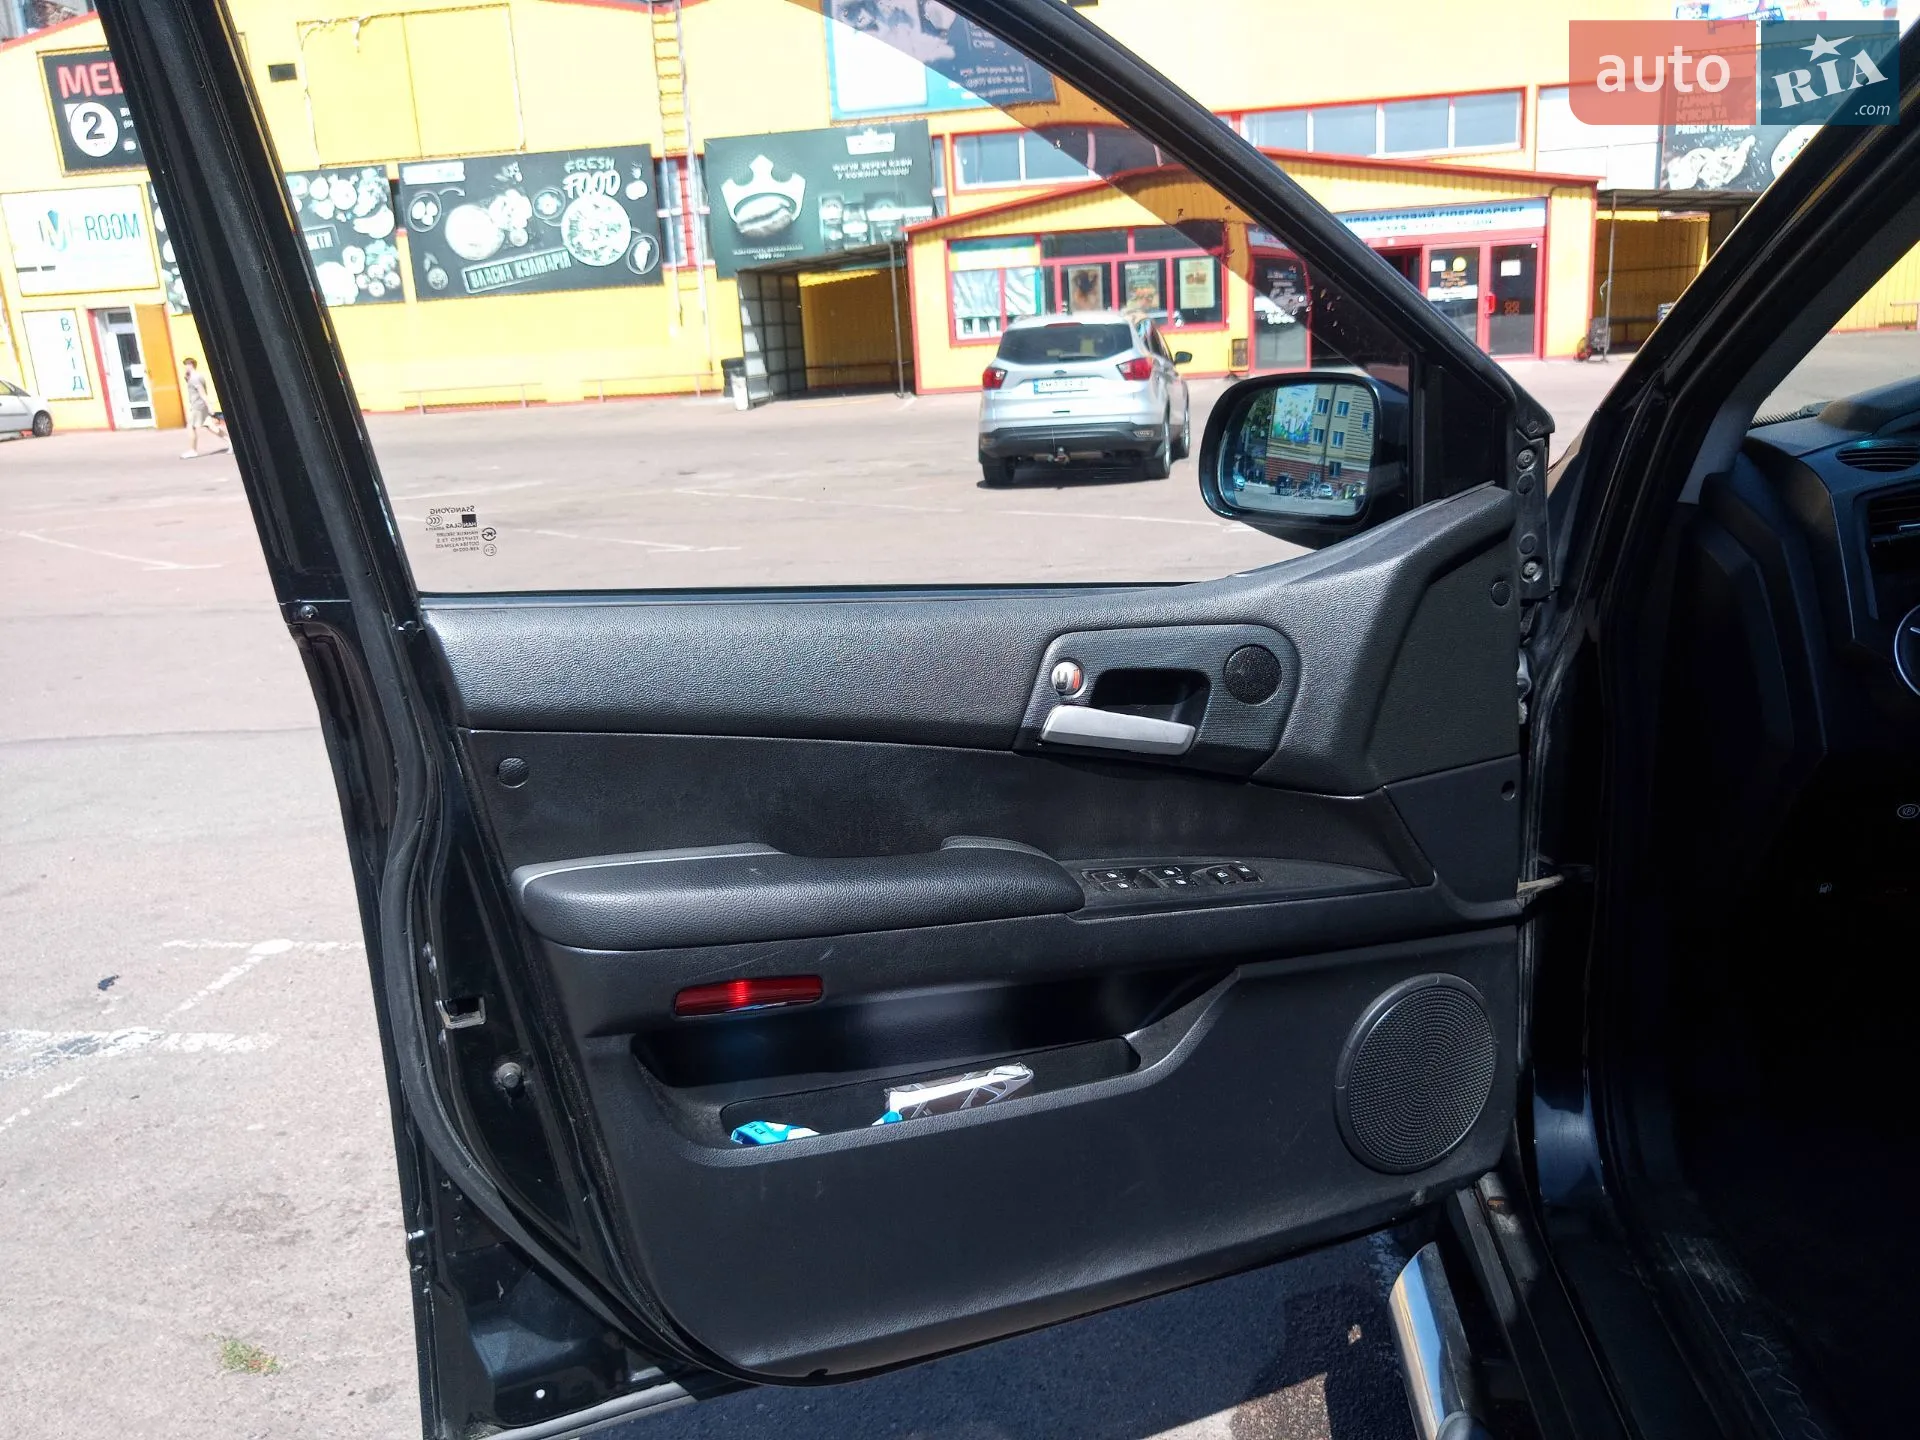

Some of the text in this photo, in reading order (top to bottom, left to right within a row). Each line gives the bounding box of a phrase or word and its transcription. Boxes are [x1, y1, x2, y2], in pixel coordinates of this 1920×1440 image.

[82, 111, 105, 141] 2
[564, 157, 615, 174] FRESH
[562, 169, 621, 199] FOOD
[1345, 211, 1435, 223] ПРОДУКТОВИЙ
[1439, 206, 1525, 217] ГІПЕРМАРКЕТ
[470, 263, 514, 289] ВЛАСНА
[60, 317, 85, 391] ВХІД
